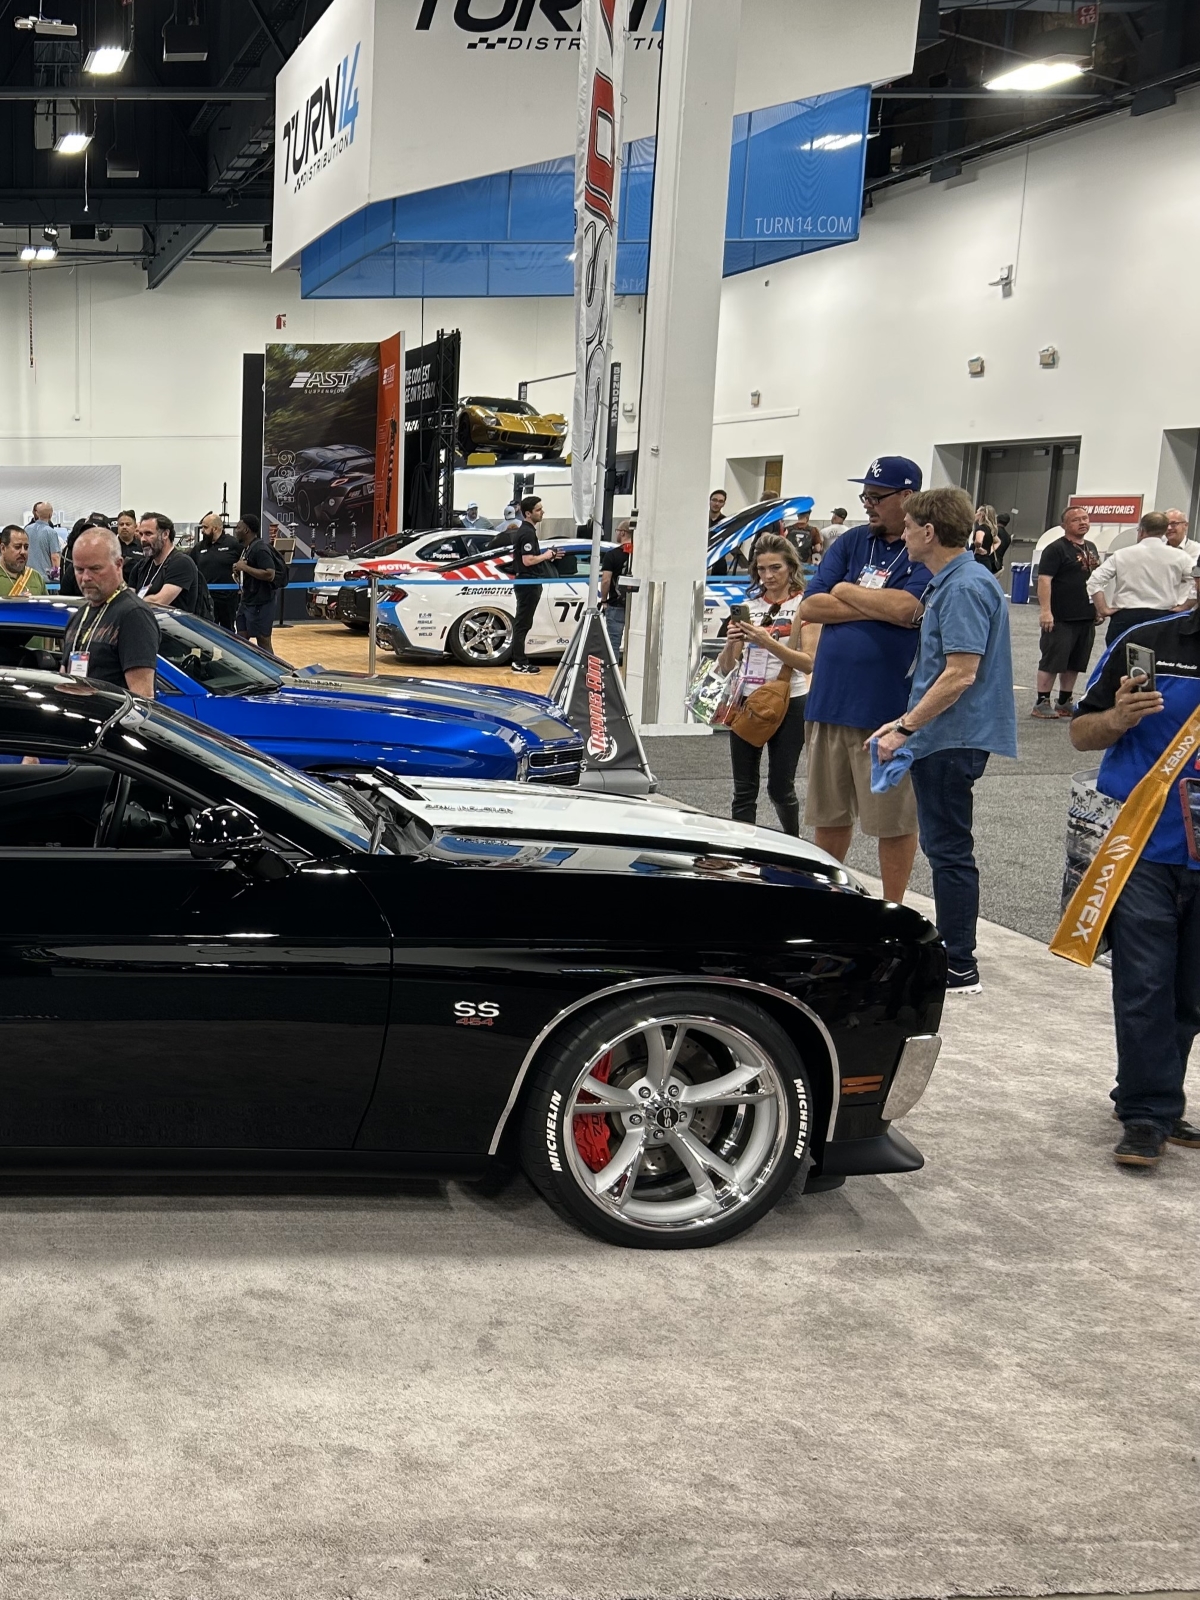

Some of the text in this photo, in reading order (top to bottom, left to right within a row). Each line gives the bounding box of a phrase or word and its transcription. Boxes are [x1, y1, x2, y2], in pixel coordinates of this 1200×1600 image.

[283, 41, 361, 184] TURN14
[302, 132, 349, 186] DISTRIBUTION
[755, 216, 852, 234] TURN14.COM
[305, 371, 355, 388] AST
[611, 366, 620, 418] BENDPAK
[1093, 505, 1135, 514] DIRECTORIES
[378, 563, 412, 571] MOTUL
[453, 1000, 500, 1017] SS
[456, 1017, 494, 1026] 454
[663, 1108, 672, 1128] SS
[793, 1078, 808, 1160] MICHELIN
[544, 1090, 562, 1172] MICHELIN
